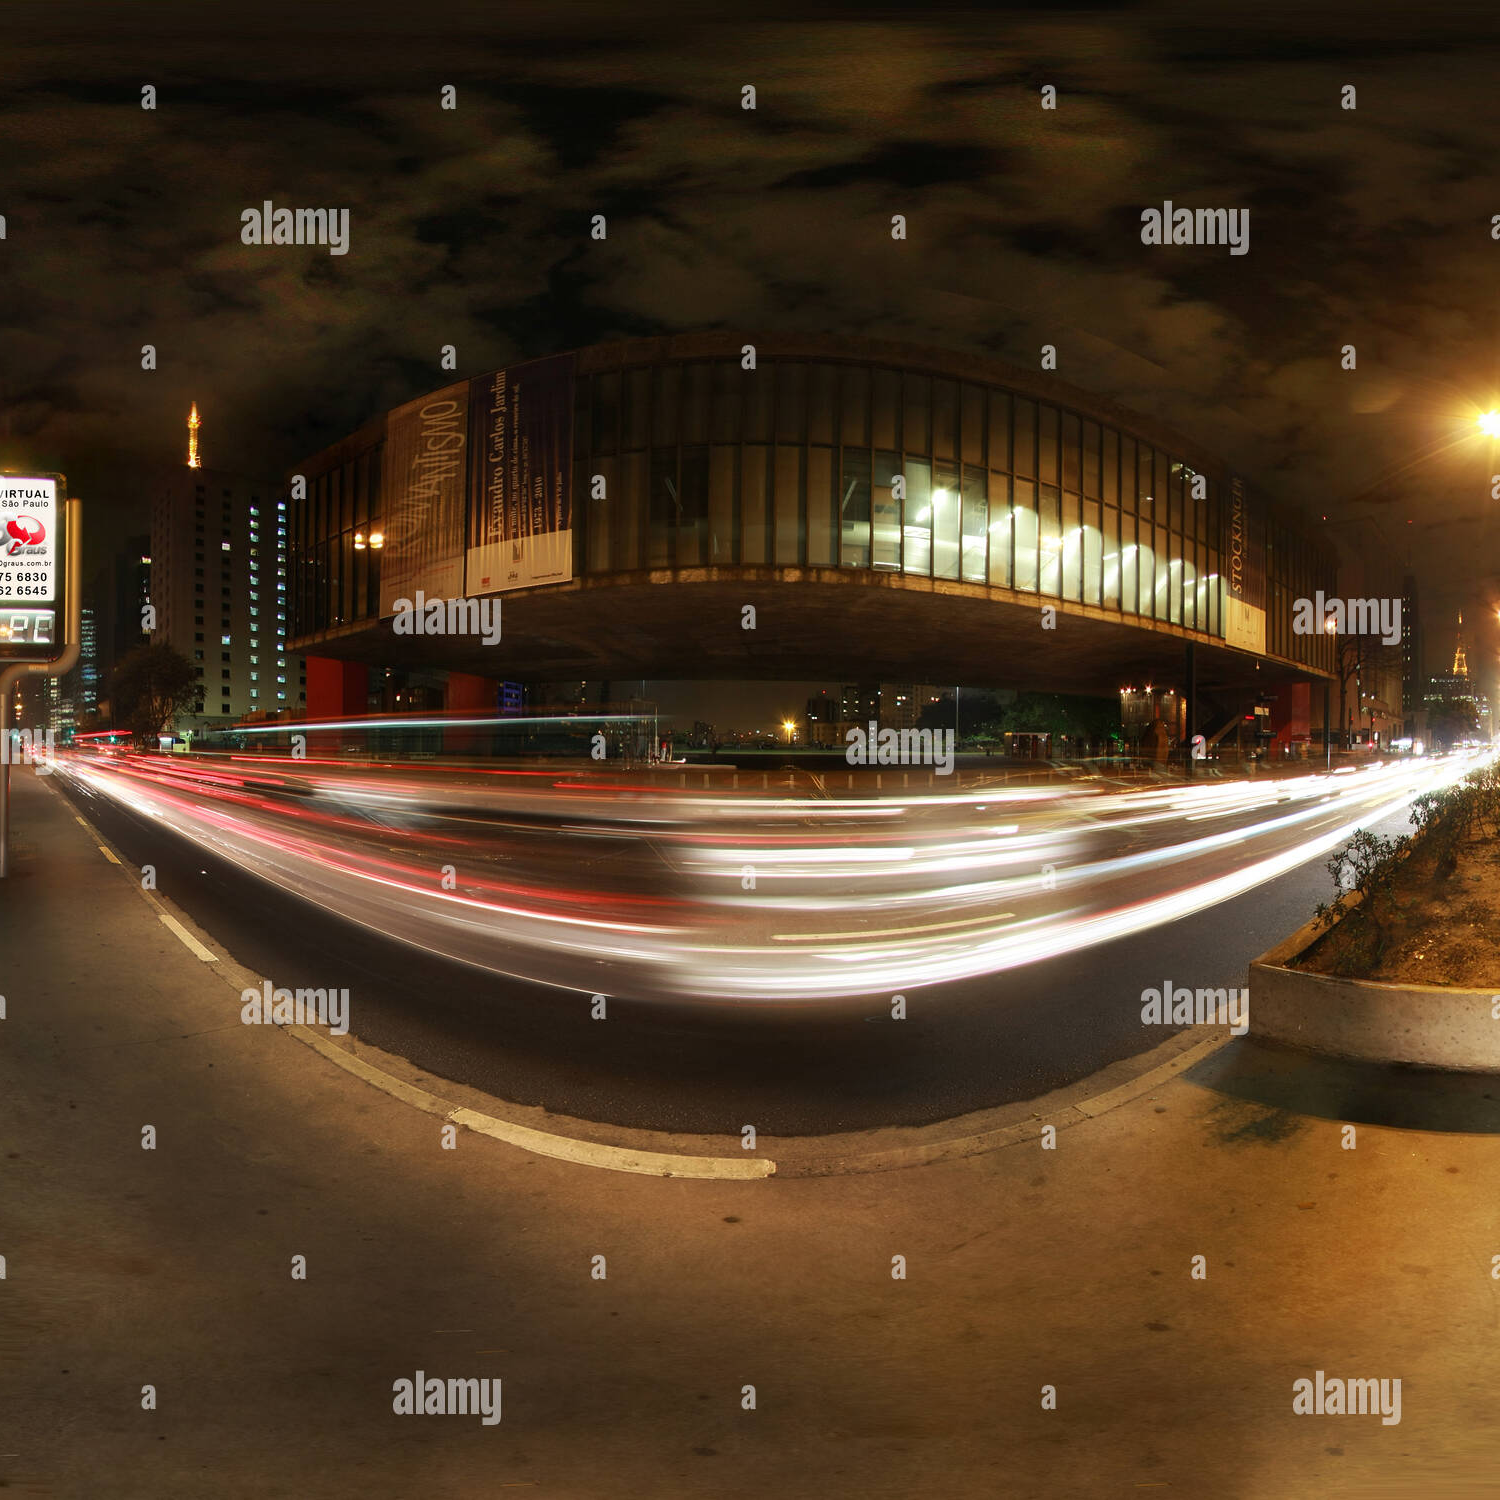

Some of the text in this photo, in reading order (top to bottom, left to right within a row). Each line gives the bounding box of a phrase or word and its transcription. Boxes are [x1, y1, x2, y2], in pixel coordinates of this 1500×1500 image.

[488, 370, 507, 537] Evandro Carlos Jardim
[385, 400, 466, 559] ROMANTISMO
[533, 476, 543, 499] 2010
[1, 500, 19, 508] São
[22, 500, 49, 508] Paulo
[1230, 477, 1244, 595] STOCKINGER
[6, 539, 47, 557] Graus
[16, 572, 48, 582] 6830
[16, 586, 48, 595] 6545
